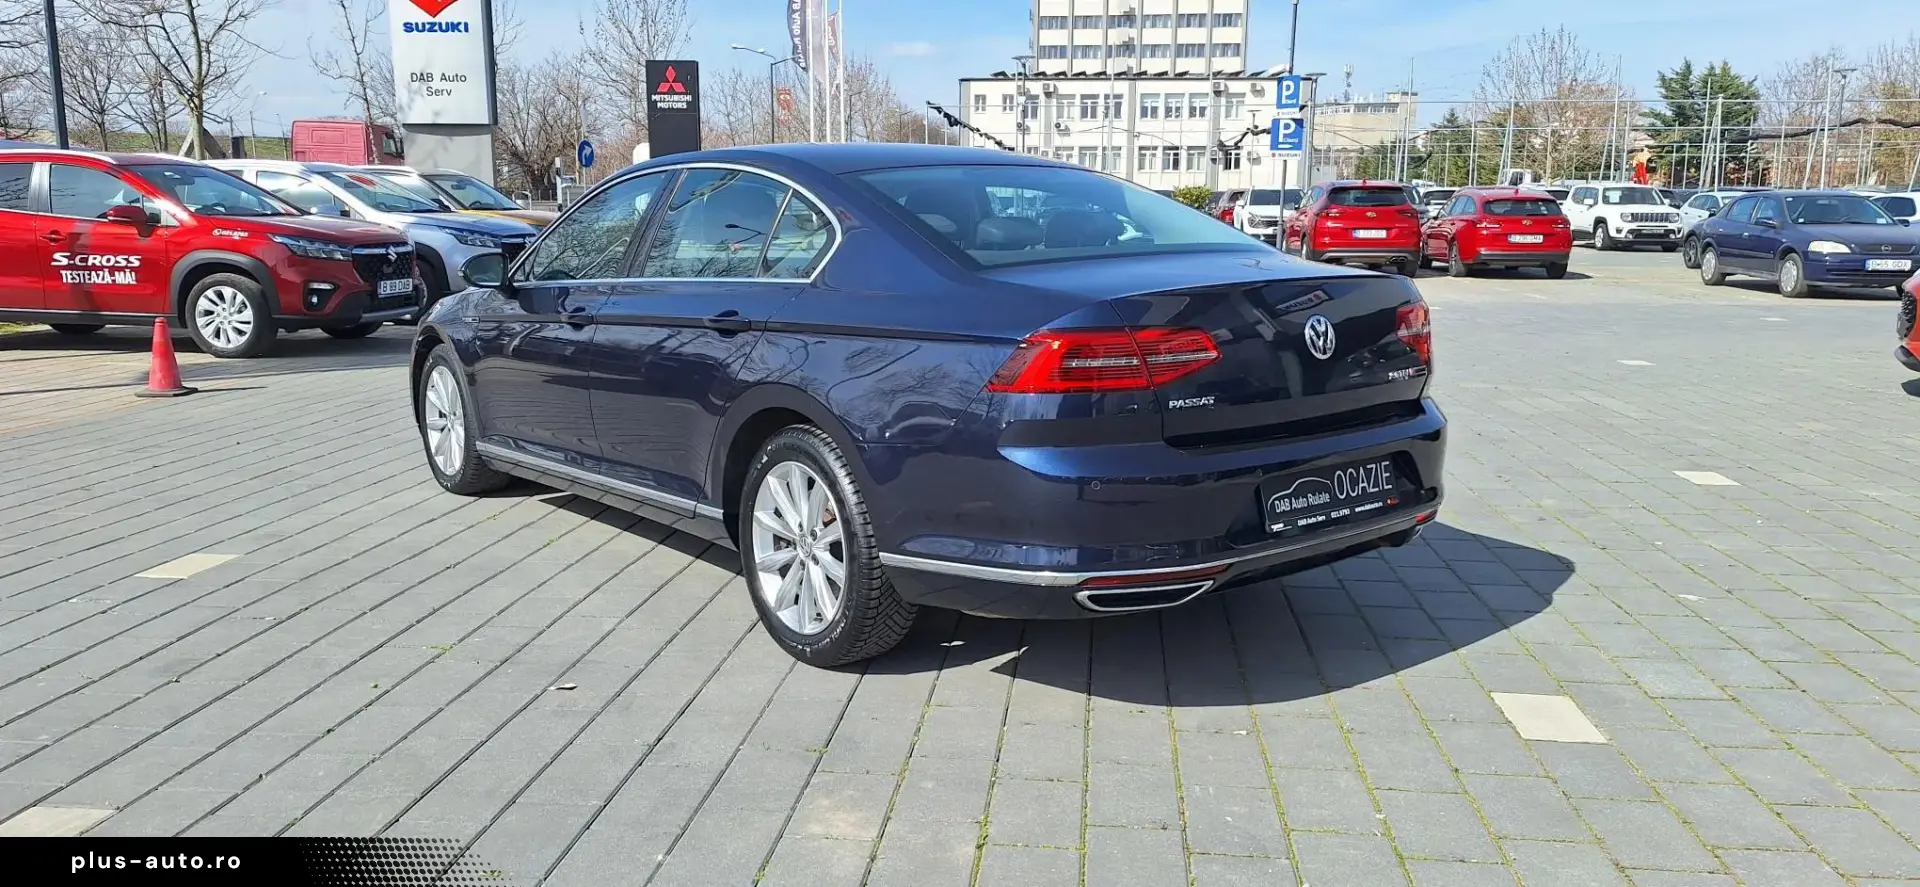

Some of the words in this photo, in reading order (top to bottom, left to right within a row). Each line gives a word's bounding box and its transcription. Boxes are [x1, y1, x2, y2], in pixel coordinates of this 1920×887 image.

[402, 21, 469, 33] SUZUKI
[410, 72, 434, 83] DAB
[439, 72, 467, 83] Auto
[426, 86, 452, 97] Serv
[651, 94, 692, 102] MITSUBISHI
[1282, 80, 1295, 104] P
[657, 101, 687, 109] MOTORS
[1278, 119, 1296, 143] P
[51, 252, 142, 267] S-CROSS
[60, 268, 137, 284] TESTEAZĂ-MĂ!
[1168, 396, 1215, 409] PASSAT
[1334, 461, 1393, 499] OCAZIE
[1274, 498, 1291, 513] DAB
[1291, 496, 1308, 510] Auto
[1307, 492, 1331, 506] Rulate
